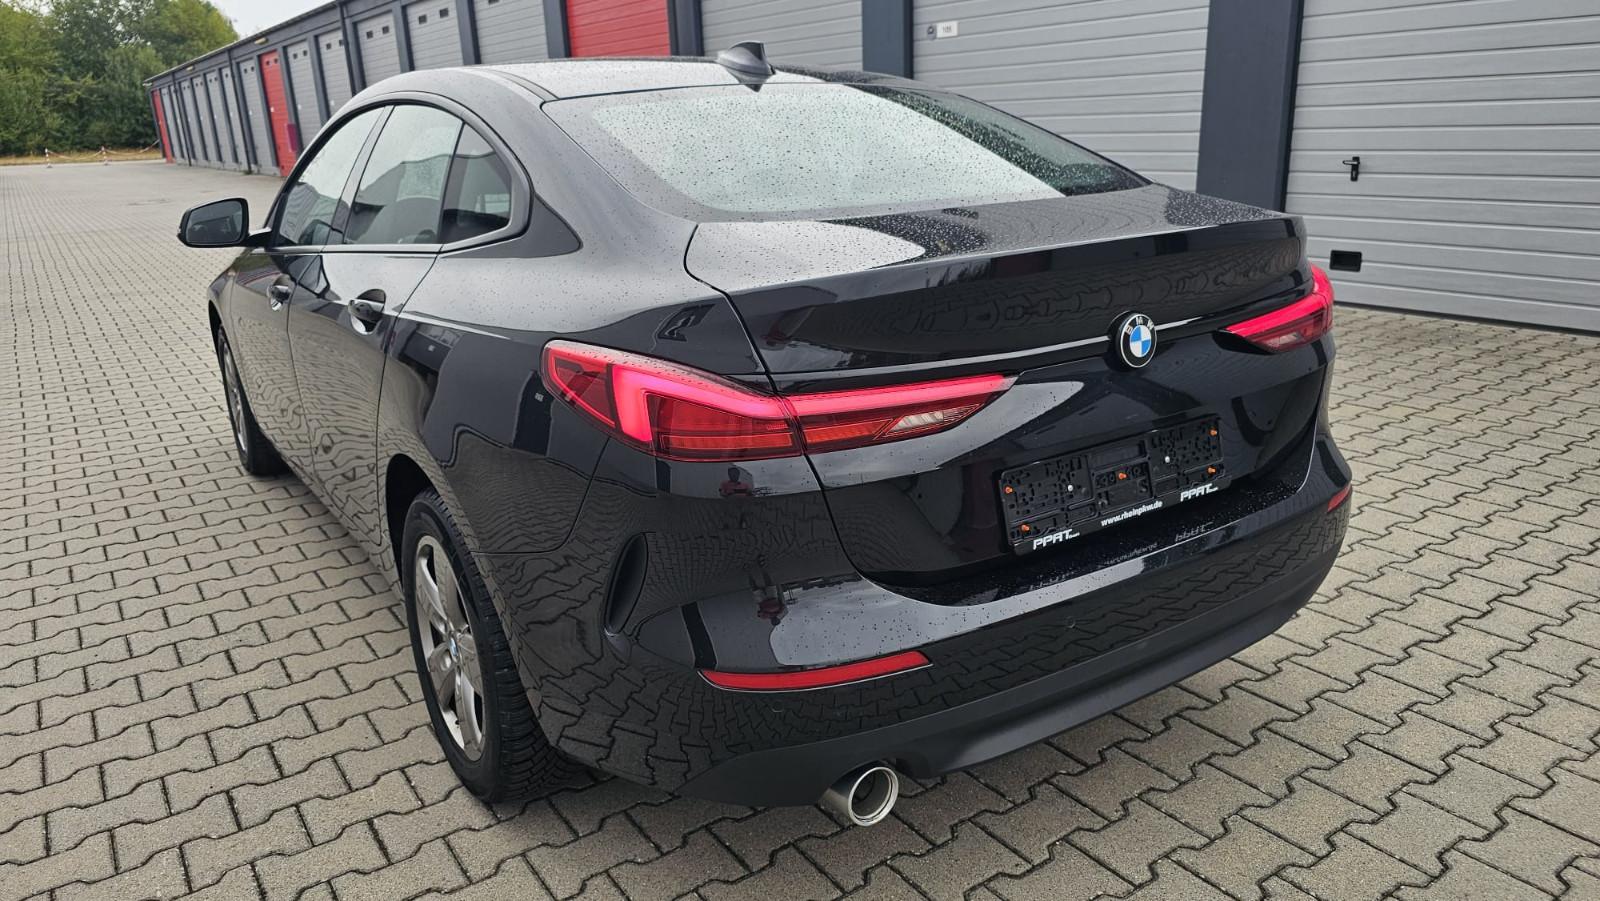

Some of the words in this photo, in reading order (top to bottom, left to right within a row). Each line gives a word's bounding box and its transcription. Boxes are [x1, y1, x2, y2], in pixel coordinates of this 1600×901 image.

[1124, 316, 1155, 335] BMW
[1180, 483, 1212, 502] PPAT
[1033, 528, 1072, 550] PPAT
